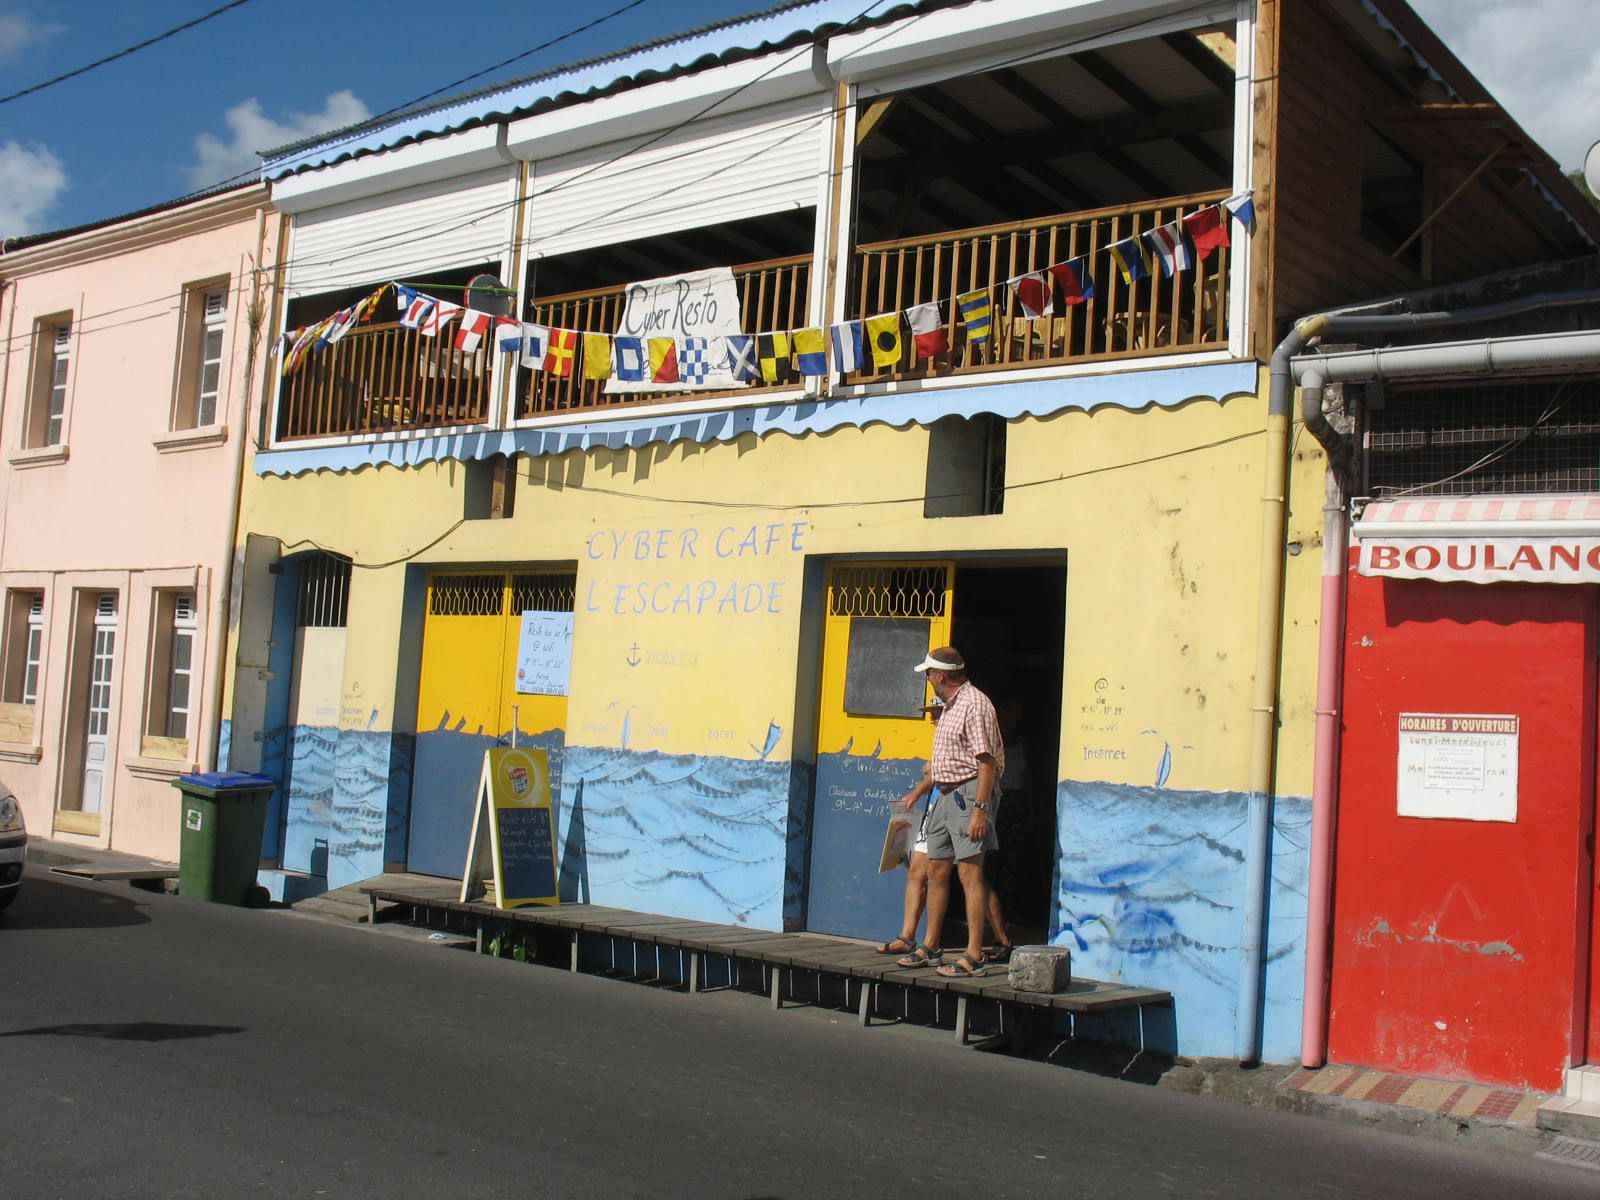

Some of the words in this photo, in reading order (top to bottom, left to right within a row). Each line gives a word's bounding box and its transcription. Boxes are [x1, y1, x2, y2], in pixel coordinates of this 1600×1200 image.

[625, 284, 671, 337] Cyber
[672, 278, 718, 337] Resto
[587, 527, 700, 560] CYBER
[1400, 717, 1447, 731] HORAIRES
[1452, 718, 1516, 733] D'OUVERTURE
[1083, 745, 1127, 761] Internet
